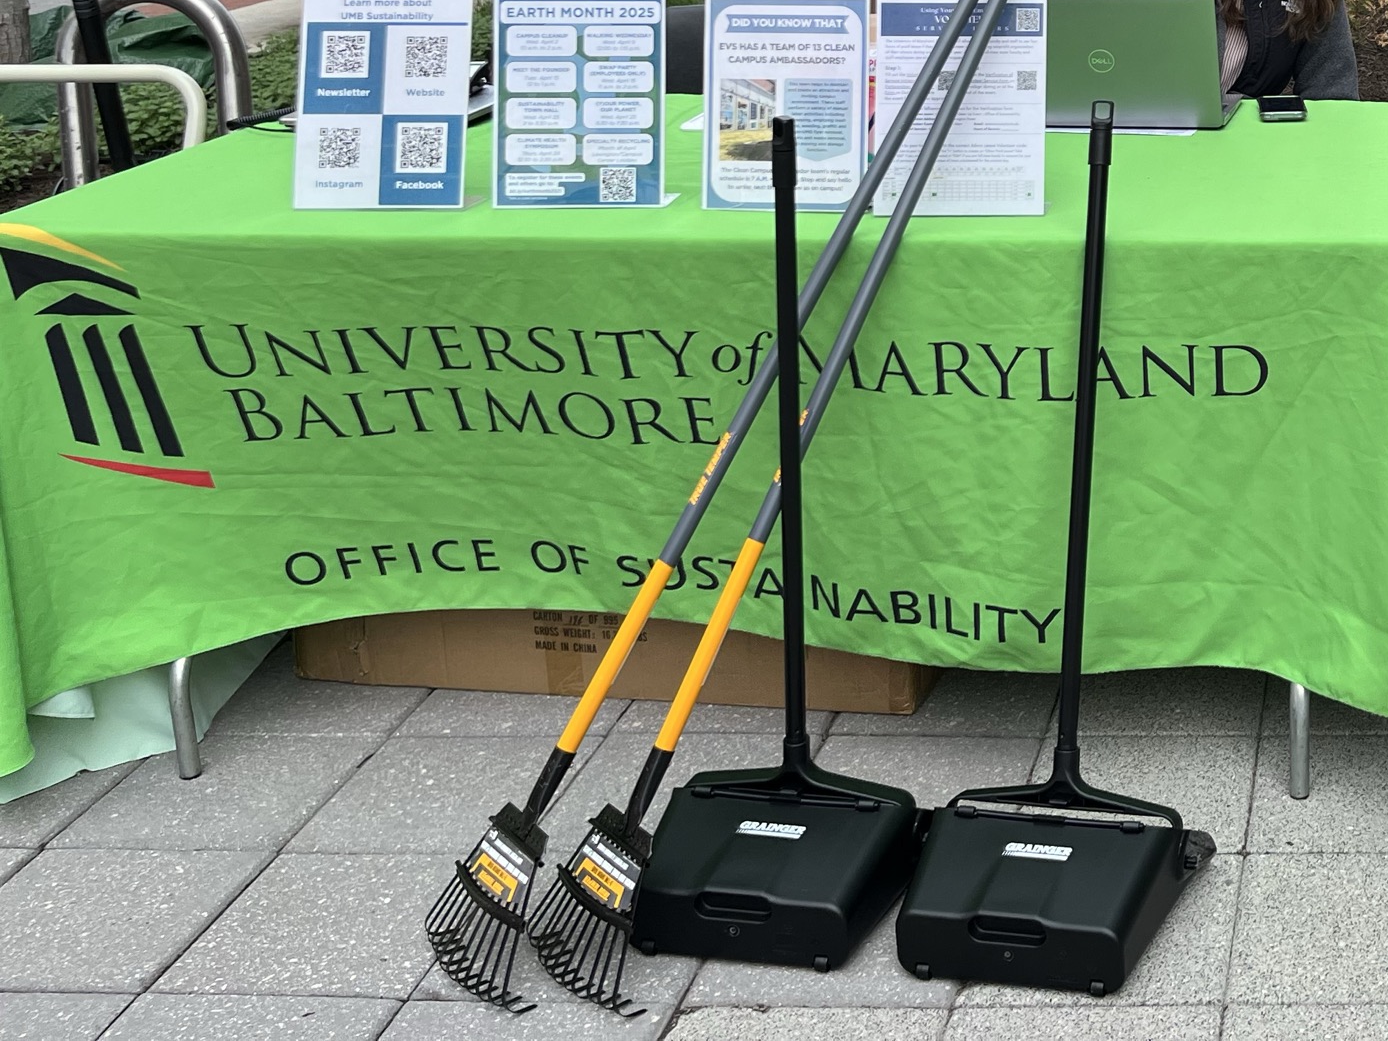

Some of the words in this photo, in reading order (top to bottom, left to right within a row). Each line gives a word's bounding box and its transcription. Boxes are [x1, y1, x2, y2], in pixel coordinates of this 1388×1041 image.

[344, 0, 371, 7] Learn
[403, 0, 432, 7] about
[341, 12, 364, 20] UMB
[366, 12, 433, 21] Sustainability
[507, 8, 555, 18] EARTH
[560, 8, 614, 18] MONTH
[619, 8, 655, 18] 2025
[732, 18, 750, 27] DID
[752, 18, 776, 27] YOU
[777, 18, 812, 27] KNOW
[814, 18, 843, 27] THAT
[720, 42, 737, 51] EVS
[740, 43, 758, 51] HAS
[760, 43, 767, 51] A
[770, 43, 795, 51] TEAM
[797, 43, 811, 51] OF
[824, 44, 855, 52] CLEAN
[728, 55, 767, 64] CAMPUS
[769, 56, 846, 65] AMBASSADORS?
[1092, 57, 1112, 65] DELL
[317, 88, 370, 97] Newsletter
[406, 88, 445, 97] Website
[316, 180, 363, 189] Instagram
[396, 181, 444, 189] Facebook
[190, 323, 700, 380] UNIVERSITY
[712, 331, 773, 387] of
[224, 387, 724, 446] BALTIMORE
[285, 539, 500, 585] OFFICE
[531, 540, 589, 575] OF
[616, 555, 1060, 643] SUSANABILITY
[533, 611, 562, 622] CARTON
[588, 614, 598, 625] OF
[534, 626, 559, 637] GROSS
[563, 628, 595, 639] WEIGHT:
[535, 640, 556, 650] MADE
[561, 642, 569, 651] IN
[574, 643, 597, 653] CHINA
[739, 820, 806, 835] GRAINGER
[1004, 842, 1073, 857] GRAINGER
